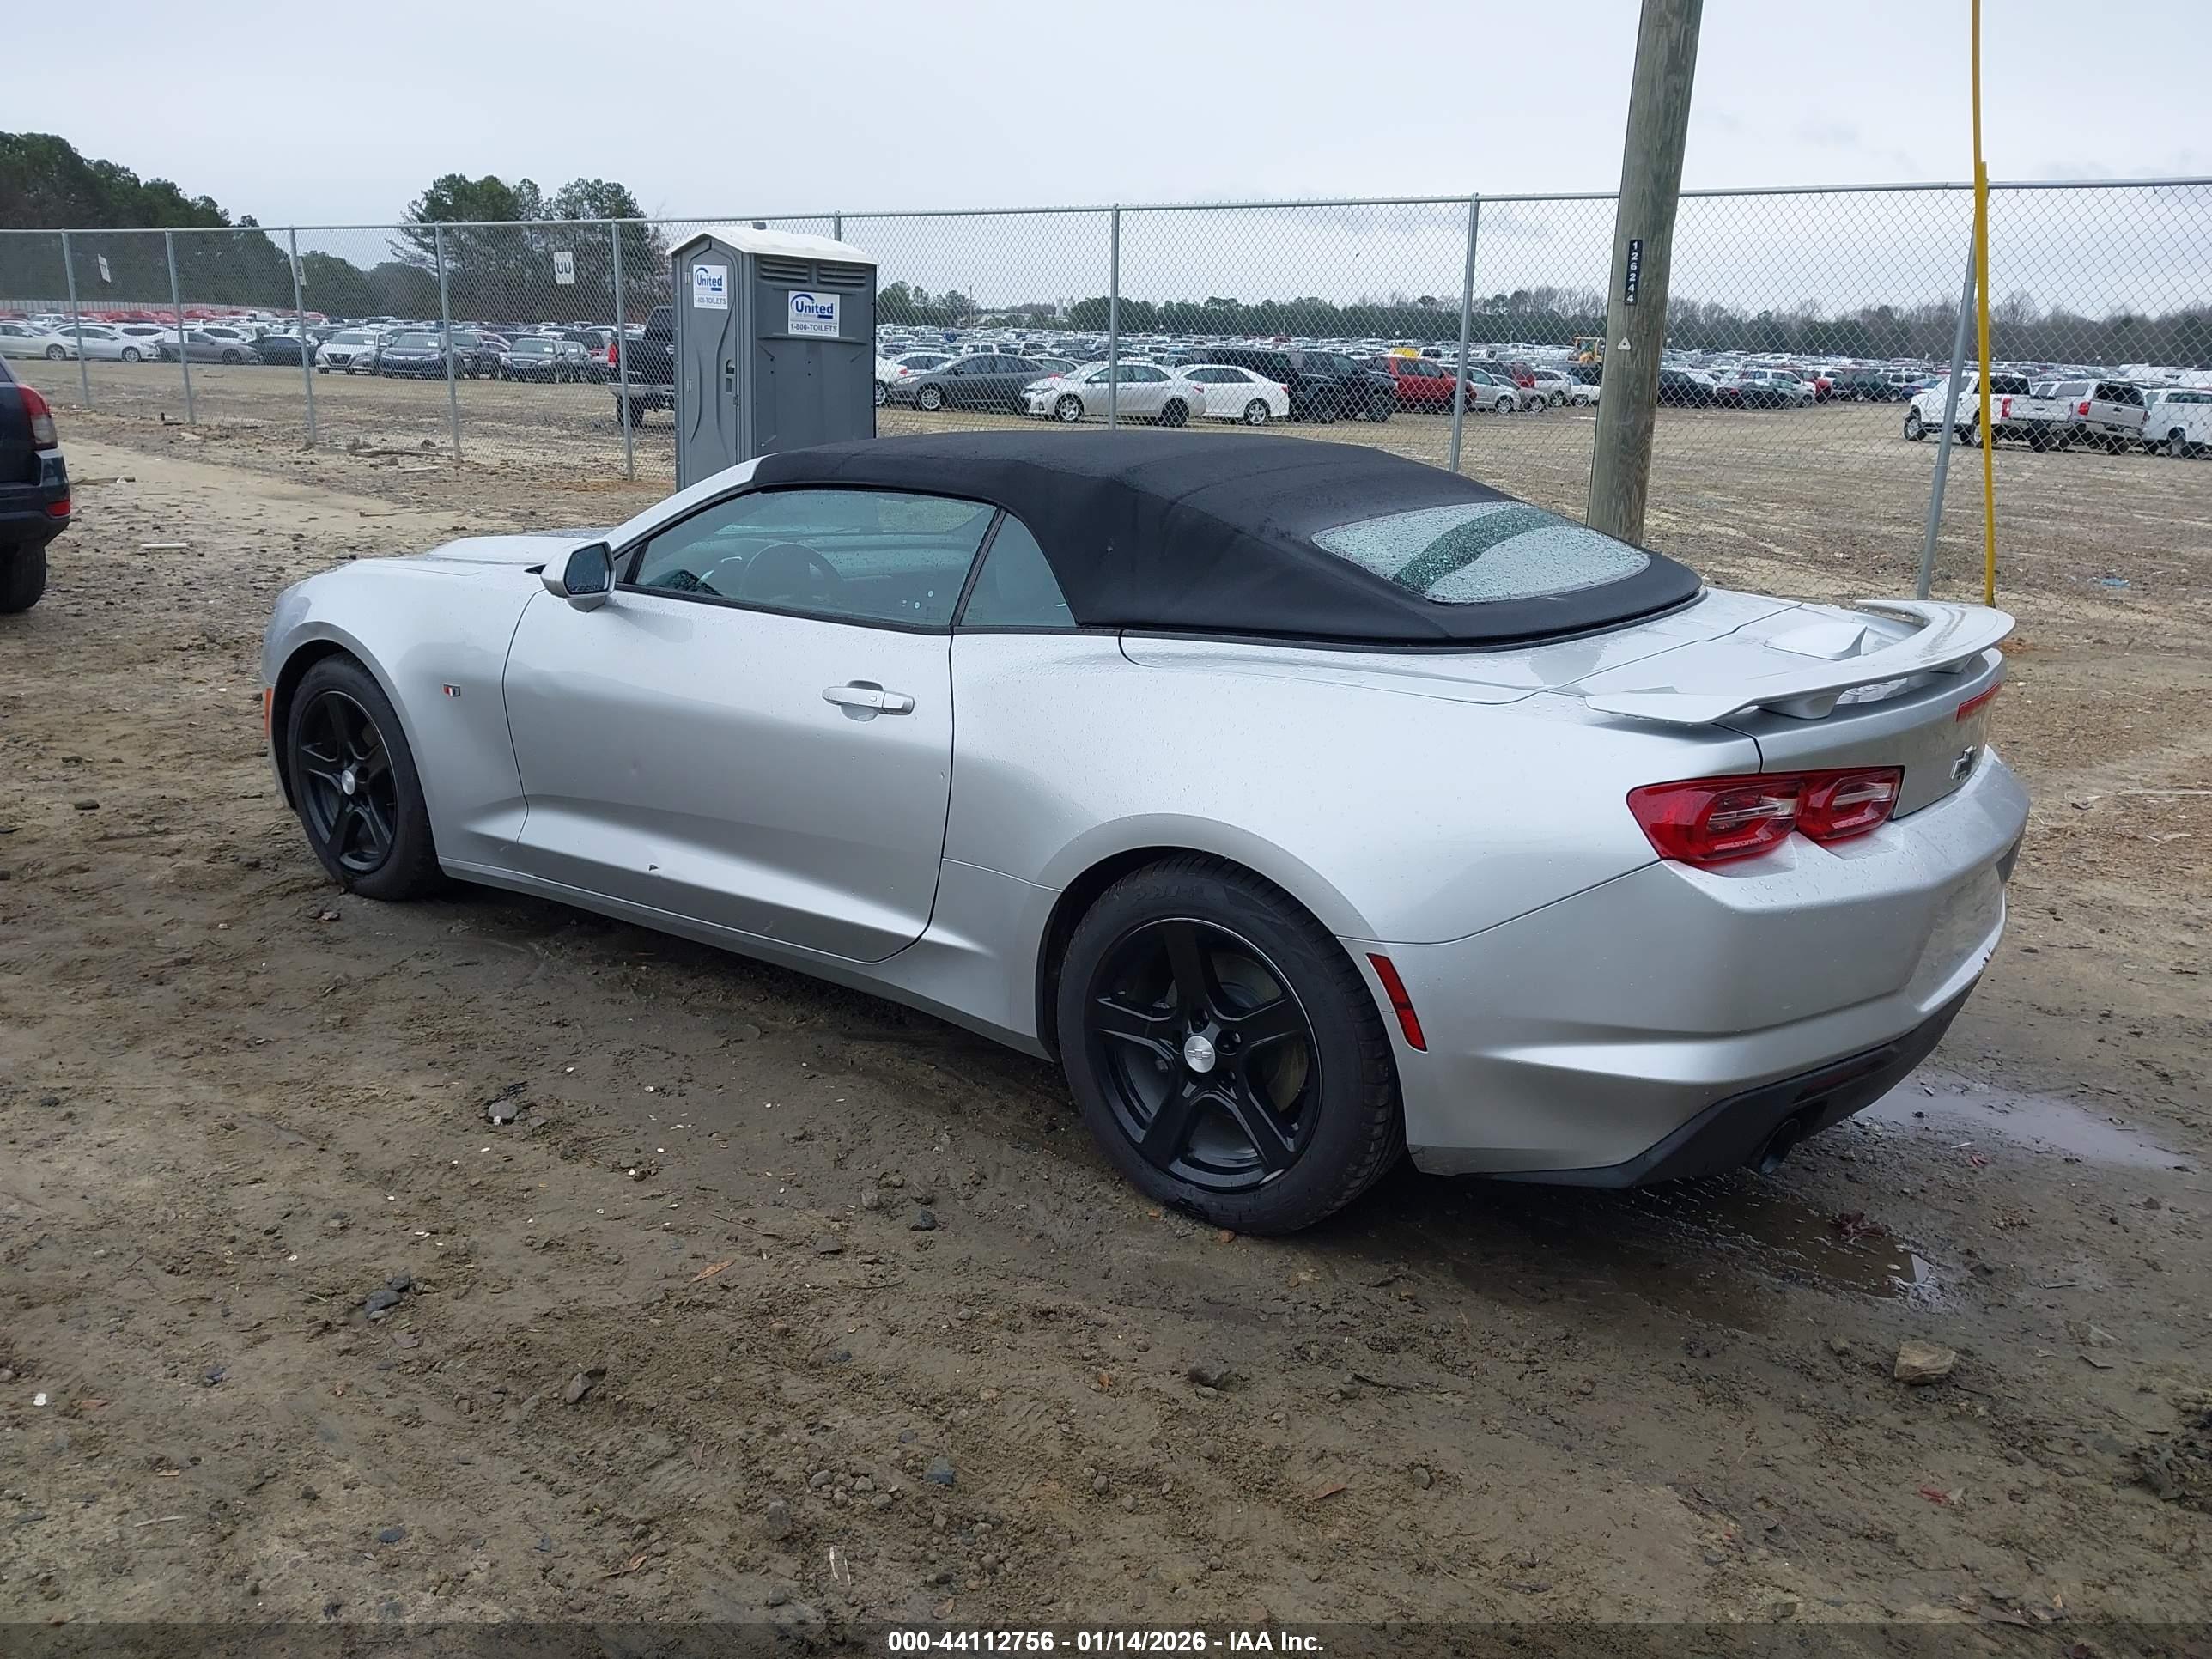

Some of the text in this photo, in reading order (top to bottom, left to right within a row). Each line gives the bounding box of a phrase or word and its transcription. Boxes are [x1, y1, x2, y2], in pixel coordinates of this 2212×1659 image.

[556, 261, 571, 275] UU
[1626, 241, 1638, 302] 126244
[696, 274, 723, 287] United
[795, 300, 834, 314] United
[790, 323, 837, 333] 1-800-TOILETS
